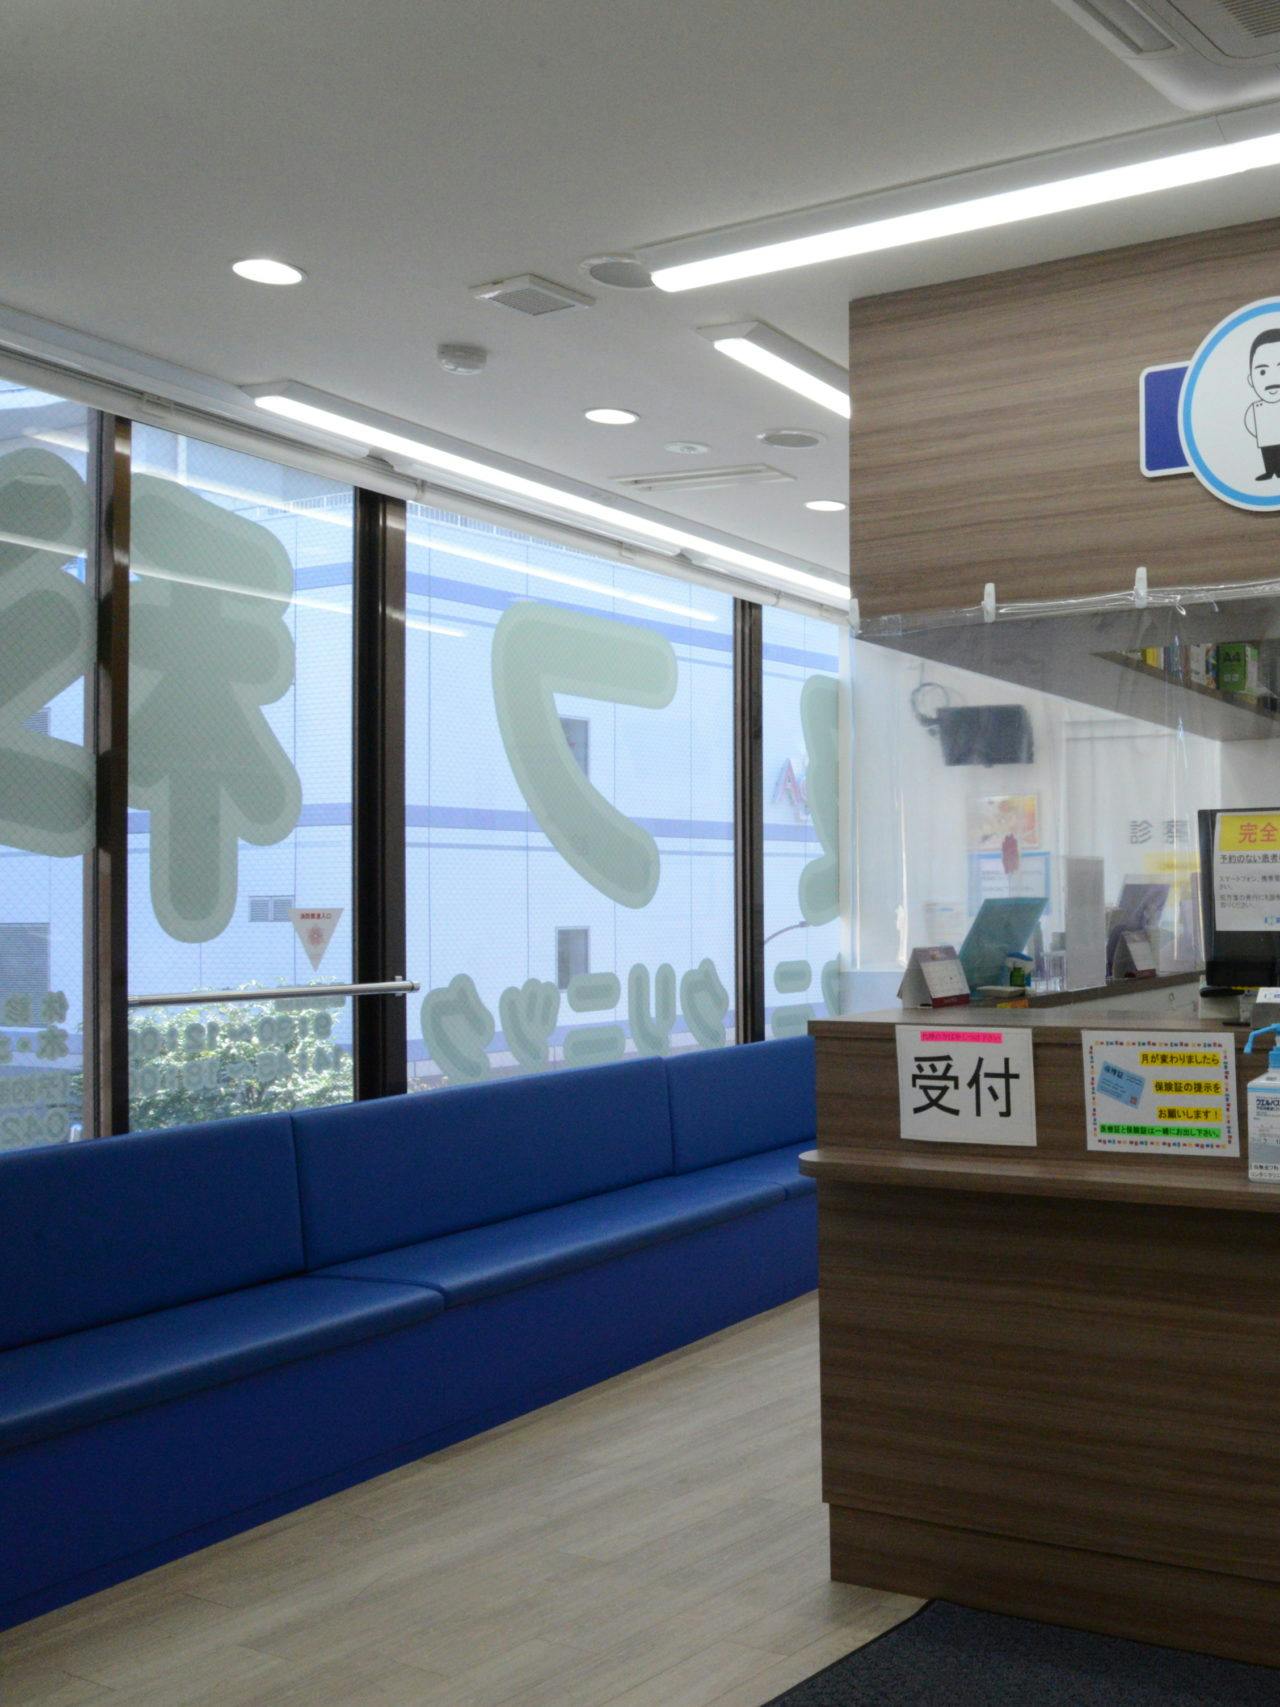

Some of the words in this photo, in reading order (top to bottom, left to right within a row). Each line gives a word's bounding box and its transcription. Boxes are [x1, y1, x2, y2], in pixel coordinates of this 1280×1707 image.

[1141, 1053, 1220, 1065] 月が変わりましたら
[911, 1054, 1020, 1118] 受付
[1154, 1081, 1222, 1094] 保険証の提示を
